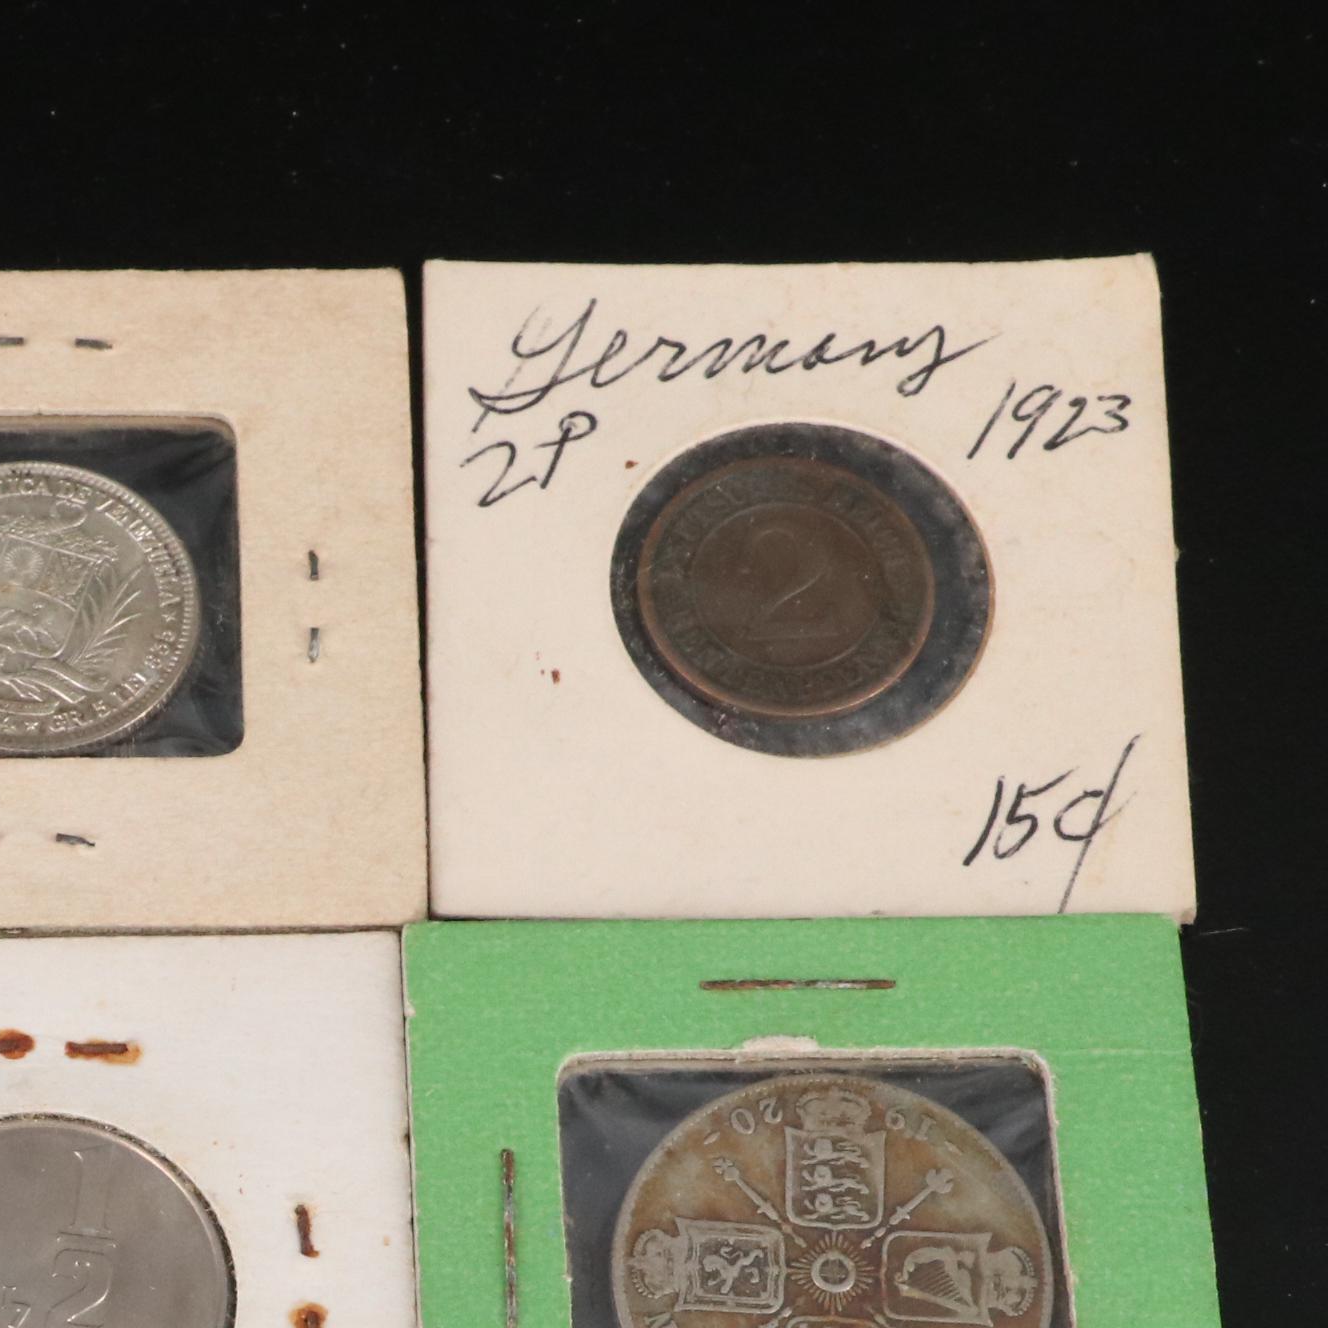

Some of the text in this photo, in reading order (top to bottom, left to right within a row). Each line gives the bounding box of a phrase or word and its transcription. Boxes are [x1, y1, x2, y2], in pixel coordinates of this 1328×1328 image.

[468, 297, 1002, 433] Germany
[967, 380, 1133, 459] 1923
[747, 525, 840, 642] 2
[729, 1098, 784, 1135] 20
[884, 1106, 941, 1142] 19
